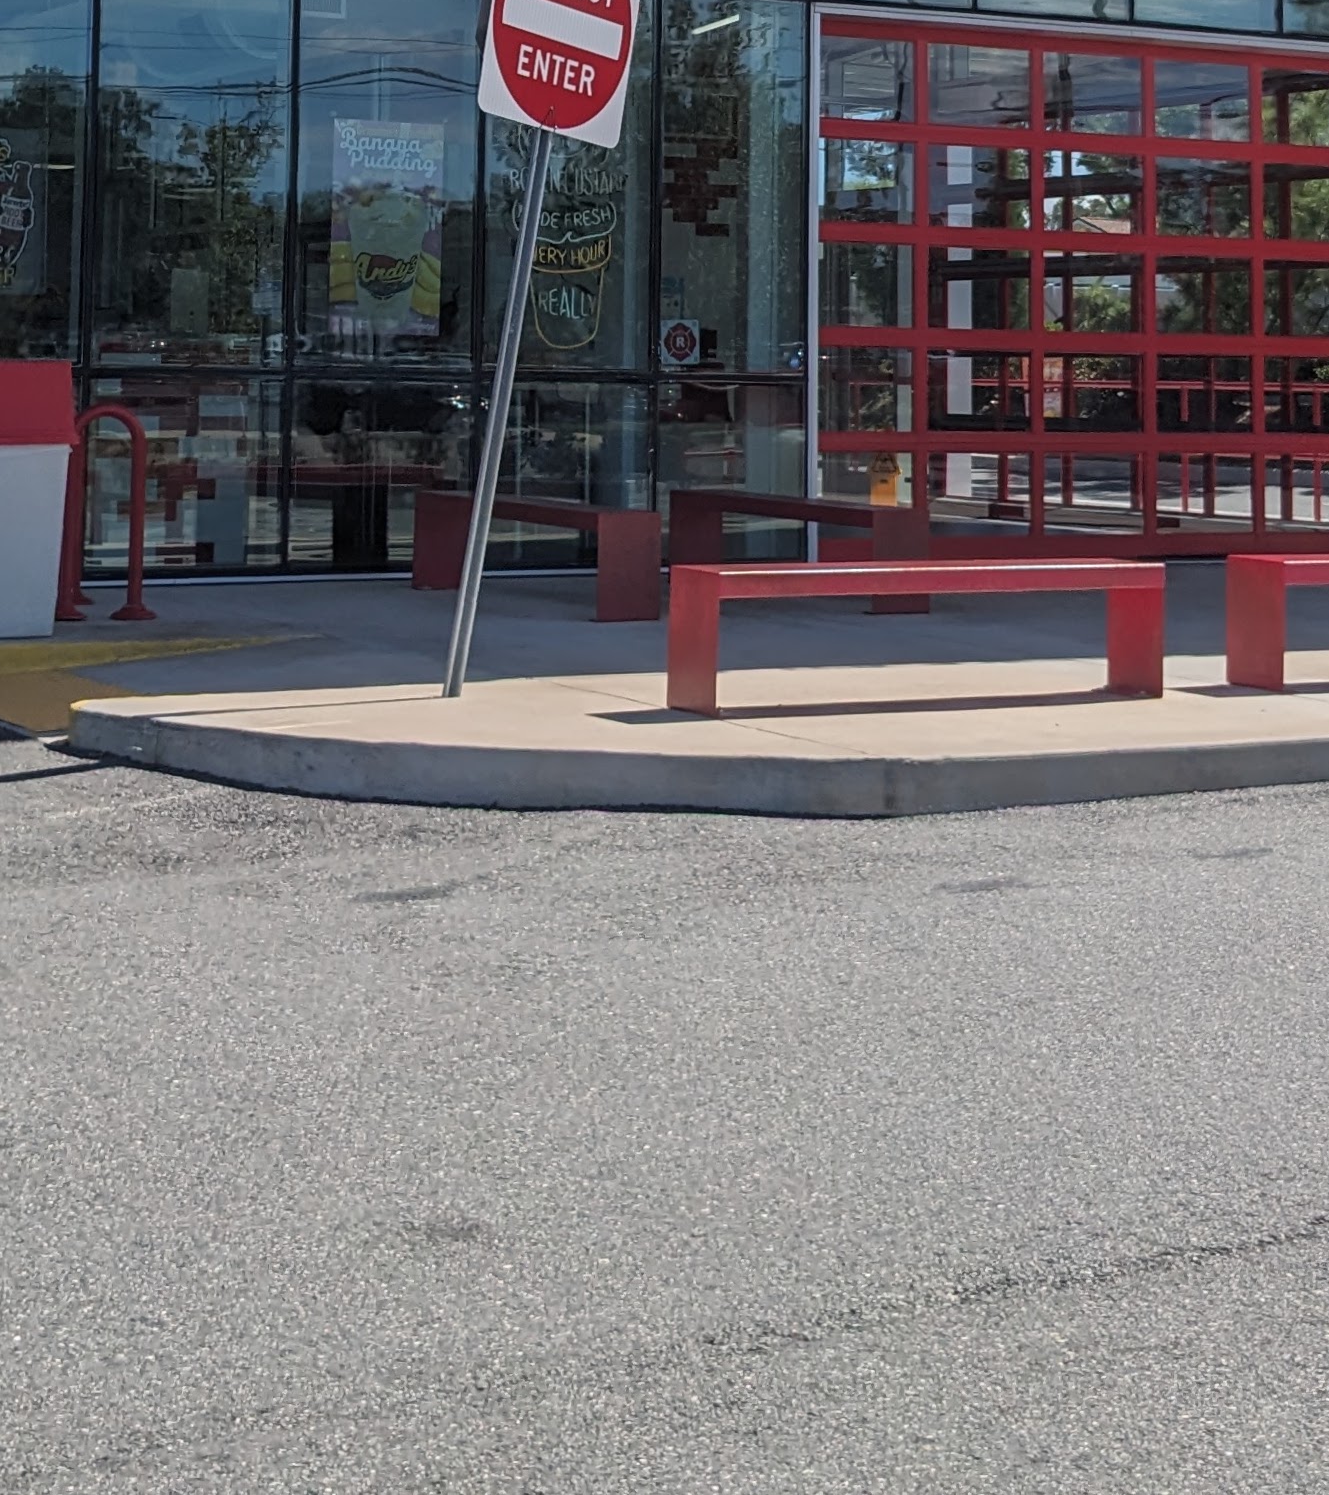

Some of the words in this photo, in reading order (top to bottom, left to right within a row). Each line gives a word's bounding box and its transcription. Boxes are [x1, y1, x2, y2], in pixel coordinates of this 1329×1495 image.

[516, 44, 595, 97] ENTER
[340, 126, 422, 154] Banana
[347, 148, 437, 179] Pudding
[563, 206, 612, 228] FRESH
[570, 239, 606, 265] HOUR
[354, 252, 419, 284] Andy's
[538, 286, 597, 320] REALLY
[675, 336, 686, 348] R
